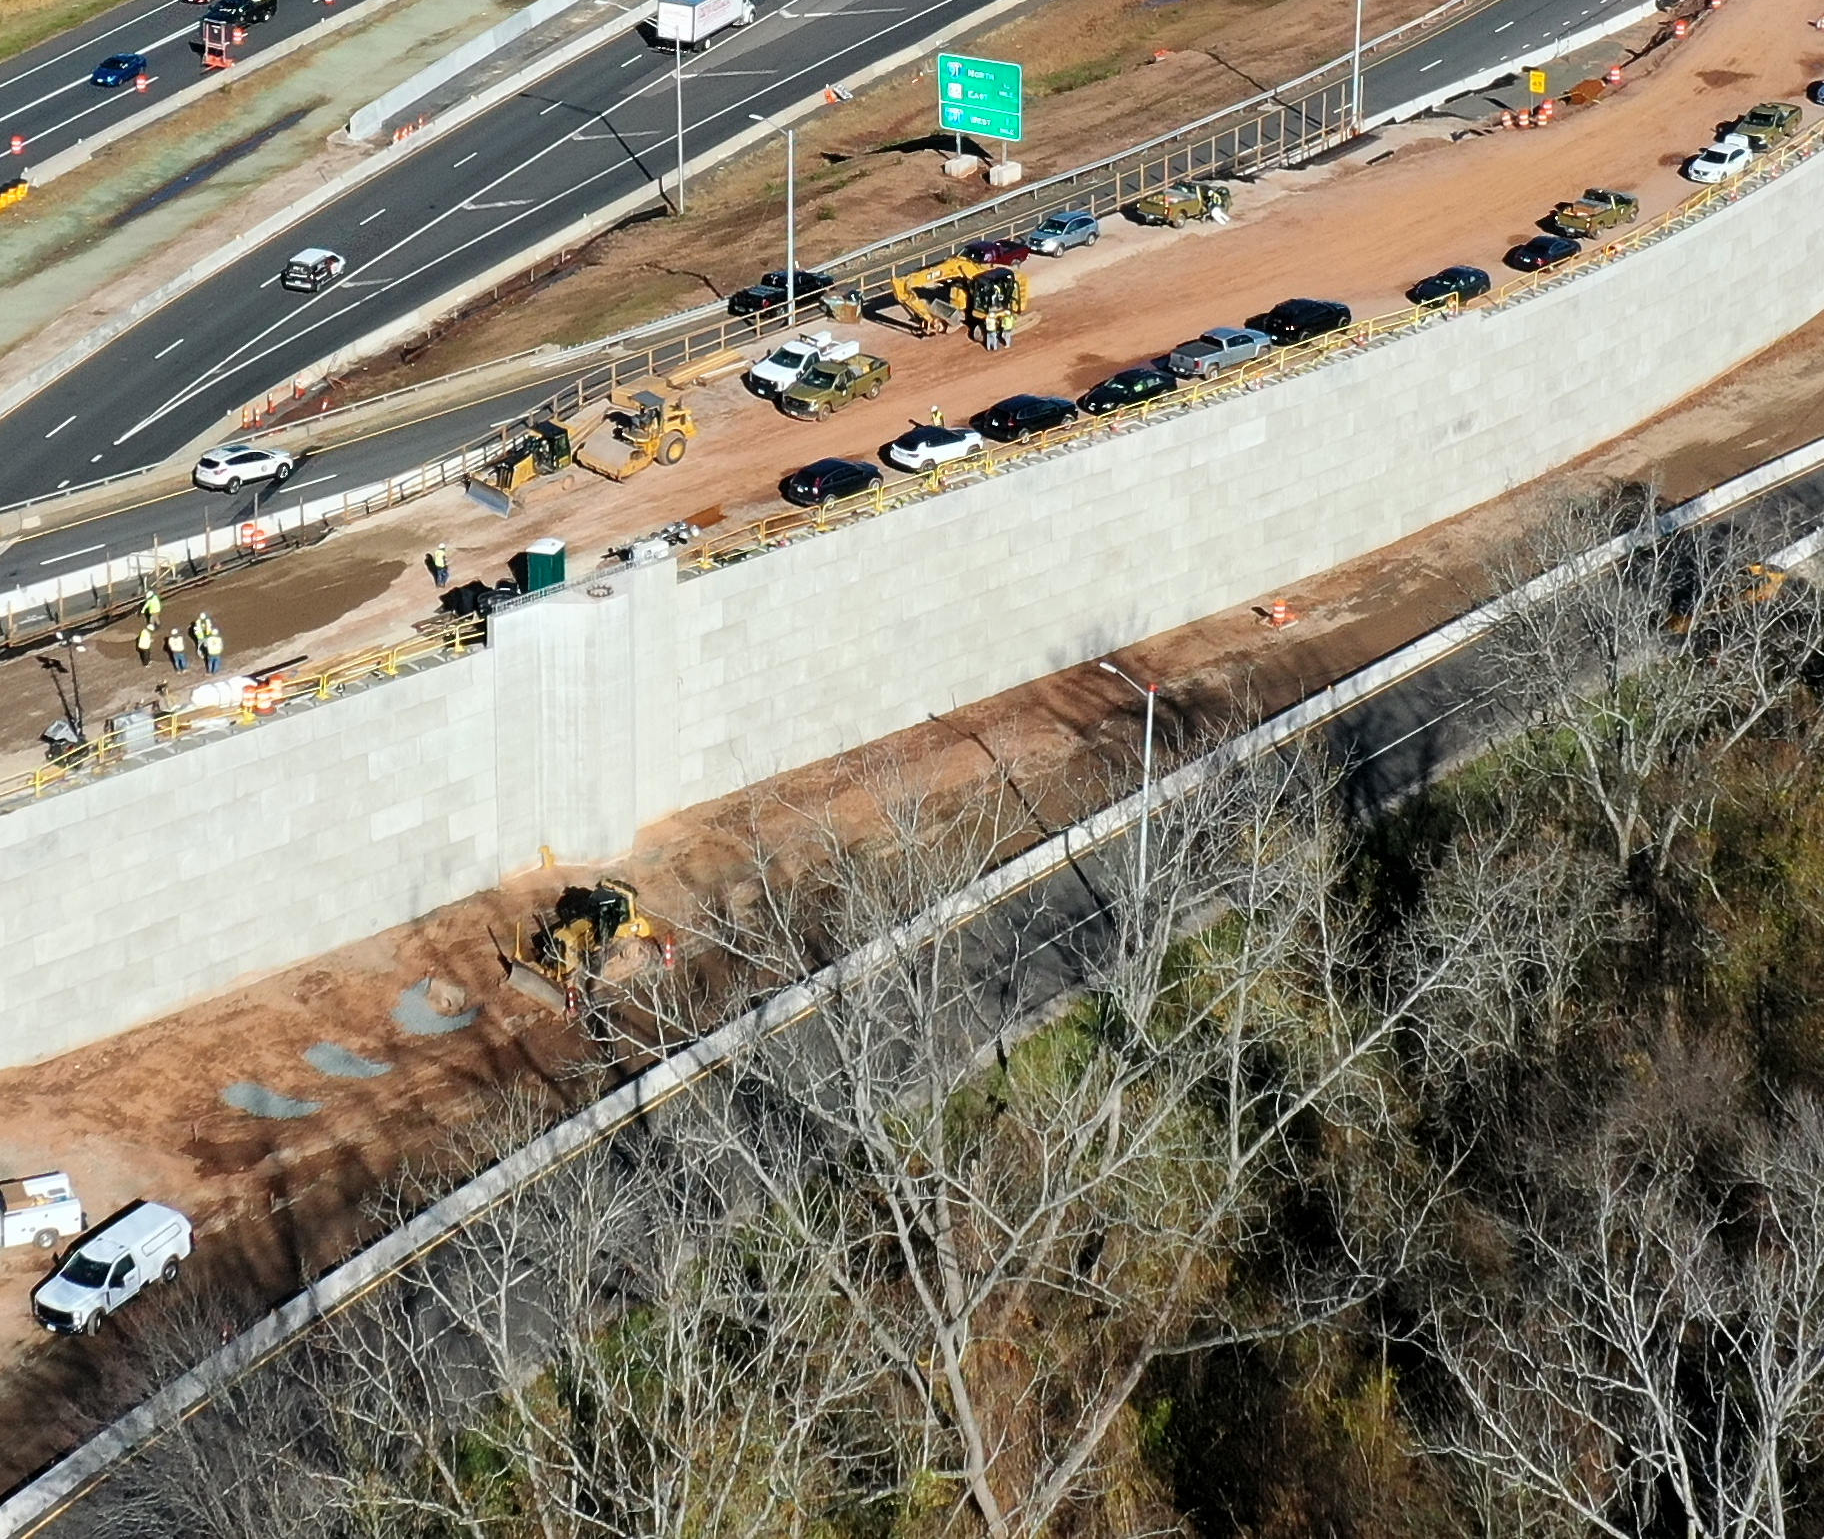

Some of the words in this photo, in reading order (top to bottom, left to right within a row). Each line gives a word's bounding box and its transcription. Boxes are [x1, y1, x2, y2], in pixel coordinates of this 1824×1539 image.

[967, 69, 995, 80] NORTH
[967, 90, 988, 100] EAST
[970, 116, 992, 126] WEST
[999, 128, 1015, 136] MILE
